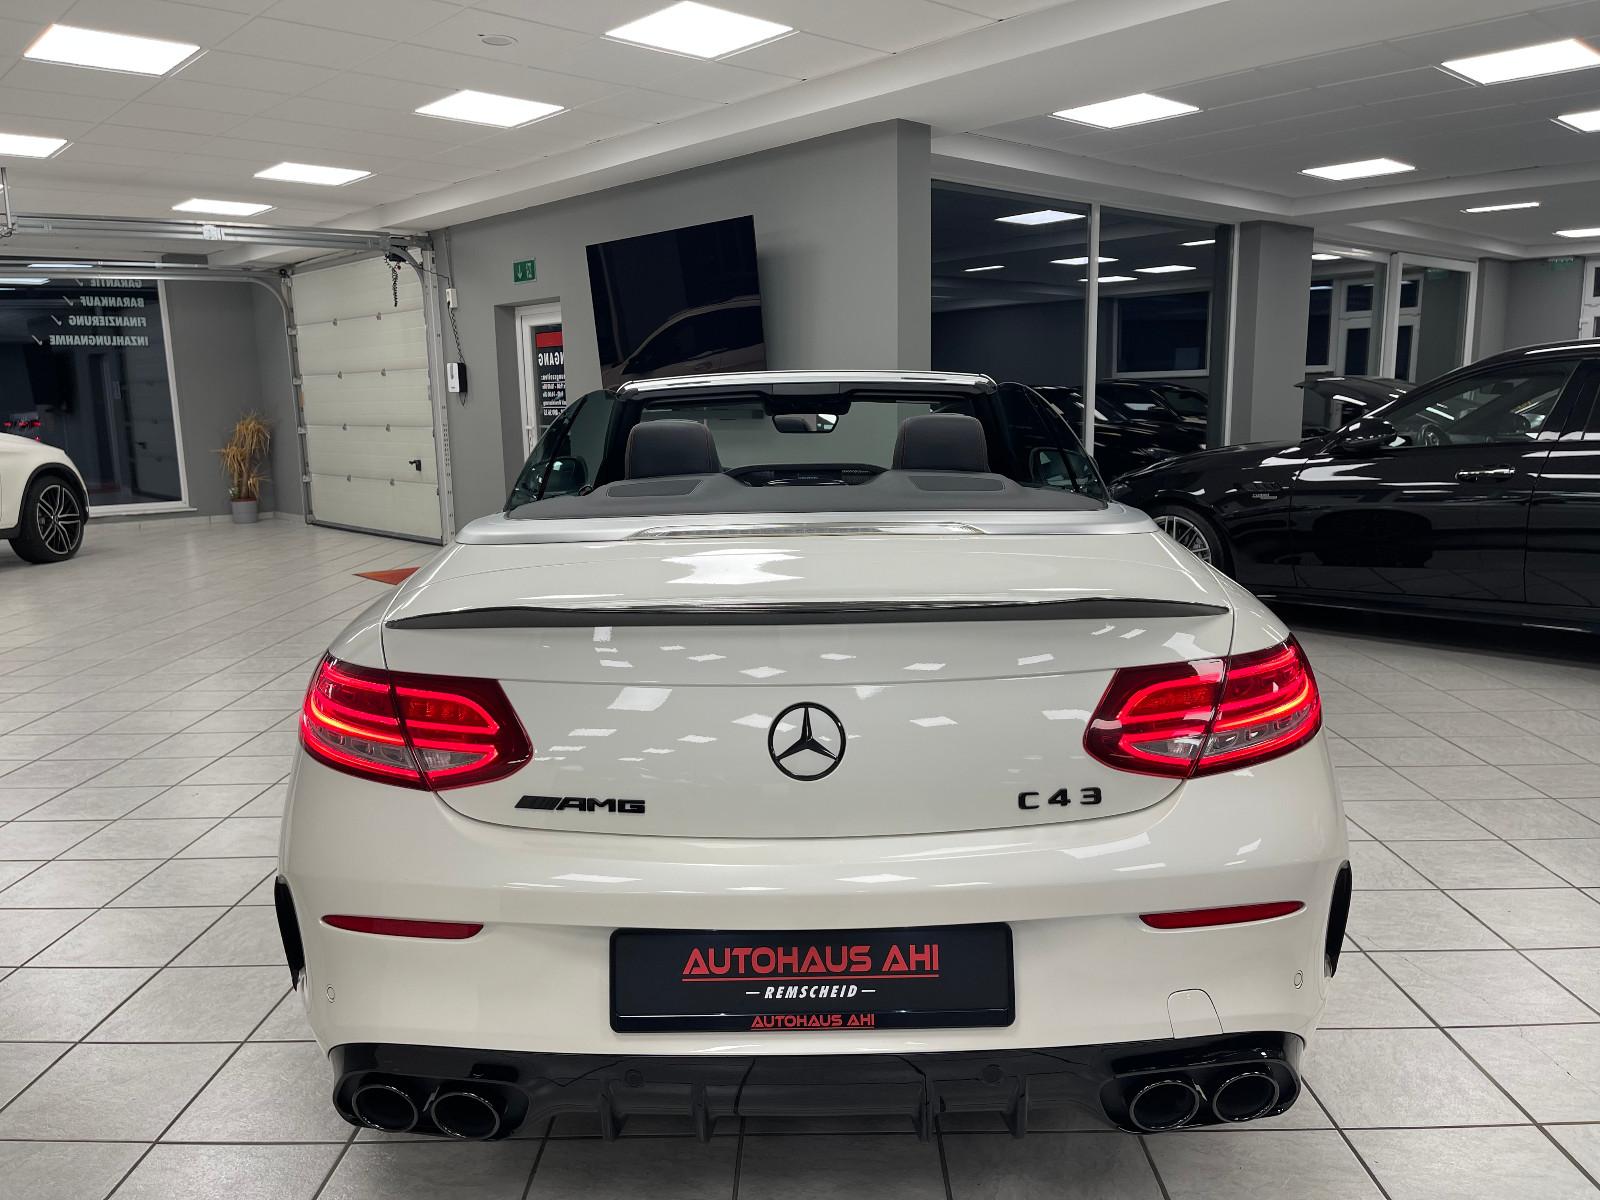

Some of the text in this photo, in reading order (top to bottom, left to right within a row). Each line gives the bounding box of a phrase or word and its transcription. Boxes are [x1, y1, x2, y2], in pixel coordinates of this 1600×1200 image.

[555, 796, 646, 814] AMG
[682, 944, 939, 975] AUTOHAUS AHI
[764, 984, 858, 999] REMSCHEID
[751, 1013, 875, 1028] AUTOHAUS AHI
